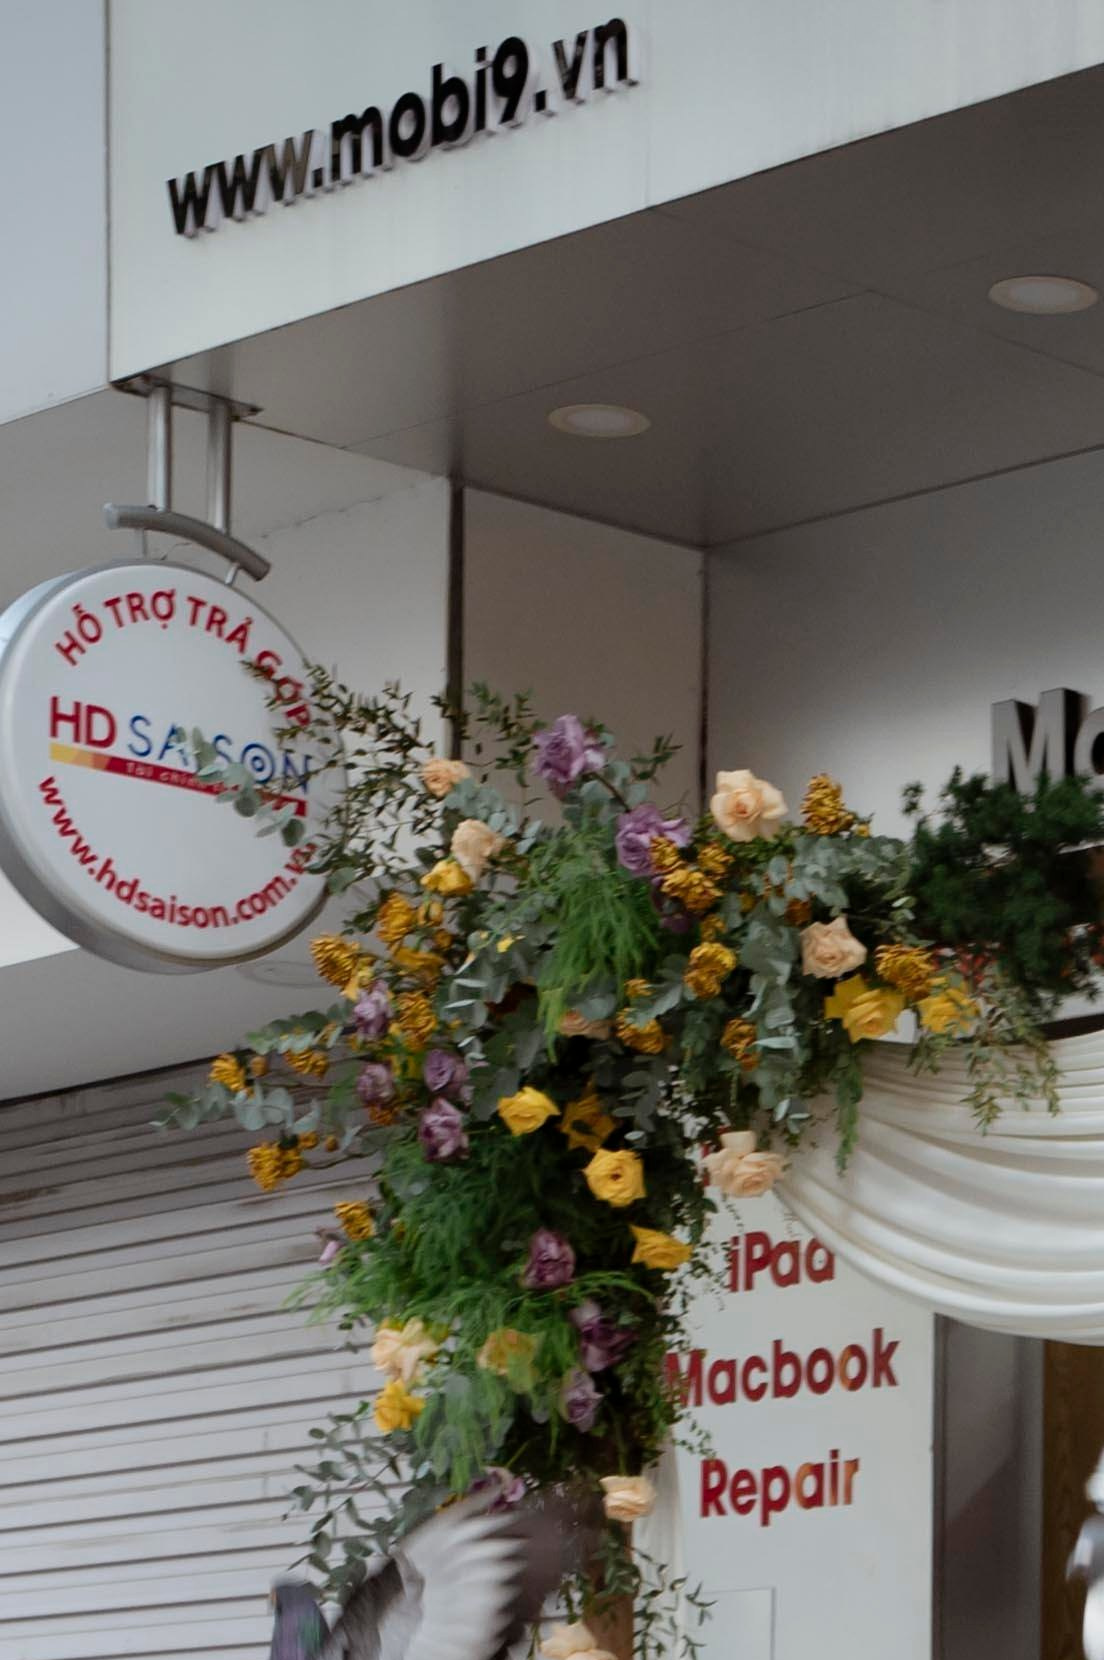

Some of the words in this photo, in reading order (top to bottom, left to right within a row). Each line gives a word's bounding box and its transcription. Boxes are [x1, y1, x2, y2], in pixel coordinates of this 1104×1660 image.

[166, 17, 637, 237] www.mobi9.vn
[55, 602, 103, 667] HỖ
[103, 589, 177, 629] TRỢ
[186, 596, 254, 654] TRẢ
[50, 696, 118, 749] HD
[664, 1327, 901, 1409] Macbook
[700, 1448, 860, 1527] Repair
